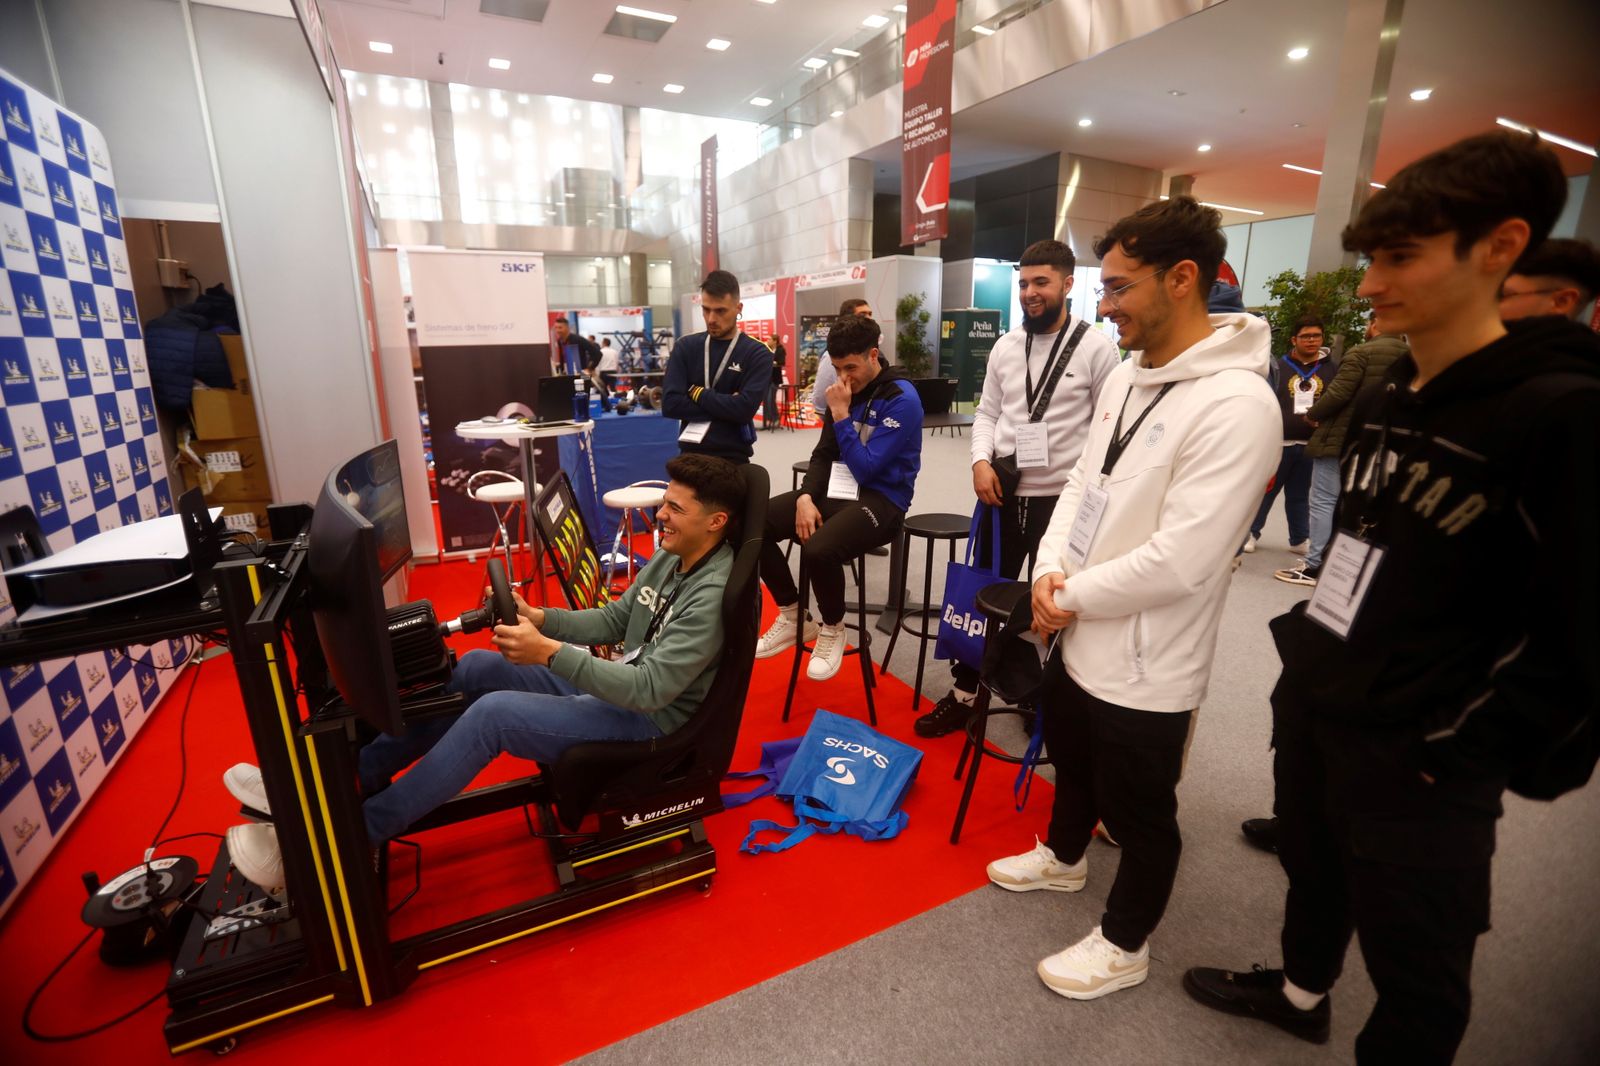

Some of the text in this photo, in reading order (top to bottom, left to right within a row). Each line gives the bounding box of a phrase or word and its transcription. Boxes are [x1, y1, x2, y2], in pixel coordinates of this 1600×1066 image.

[924, 107, 943, 124] TALLER
[908, 122, 936, 139] RECAMBIO
[501, 263, 536, 273] SKF
[973, 321, 992, 330] Peña
[388, 617, 422, 631] FANATEC
[943, 603, 1005, 637] Delp
[823, 737, 889, 769] SACHS
[644, 797, 704, 821] MICHELIN
